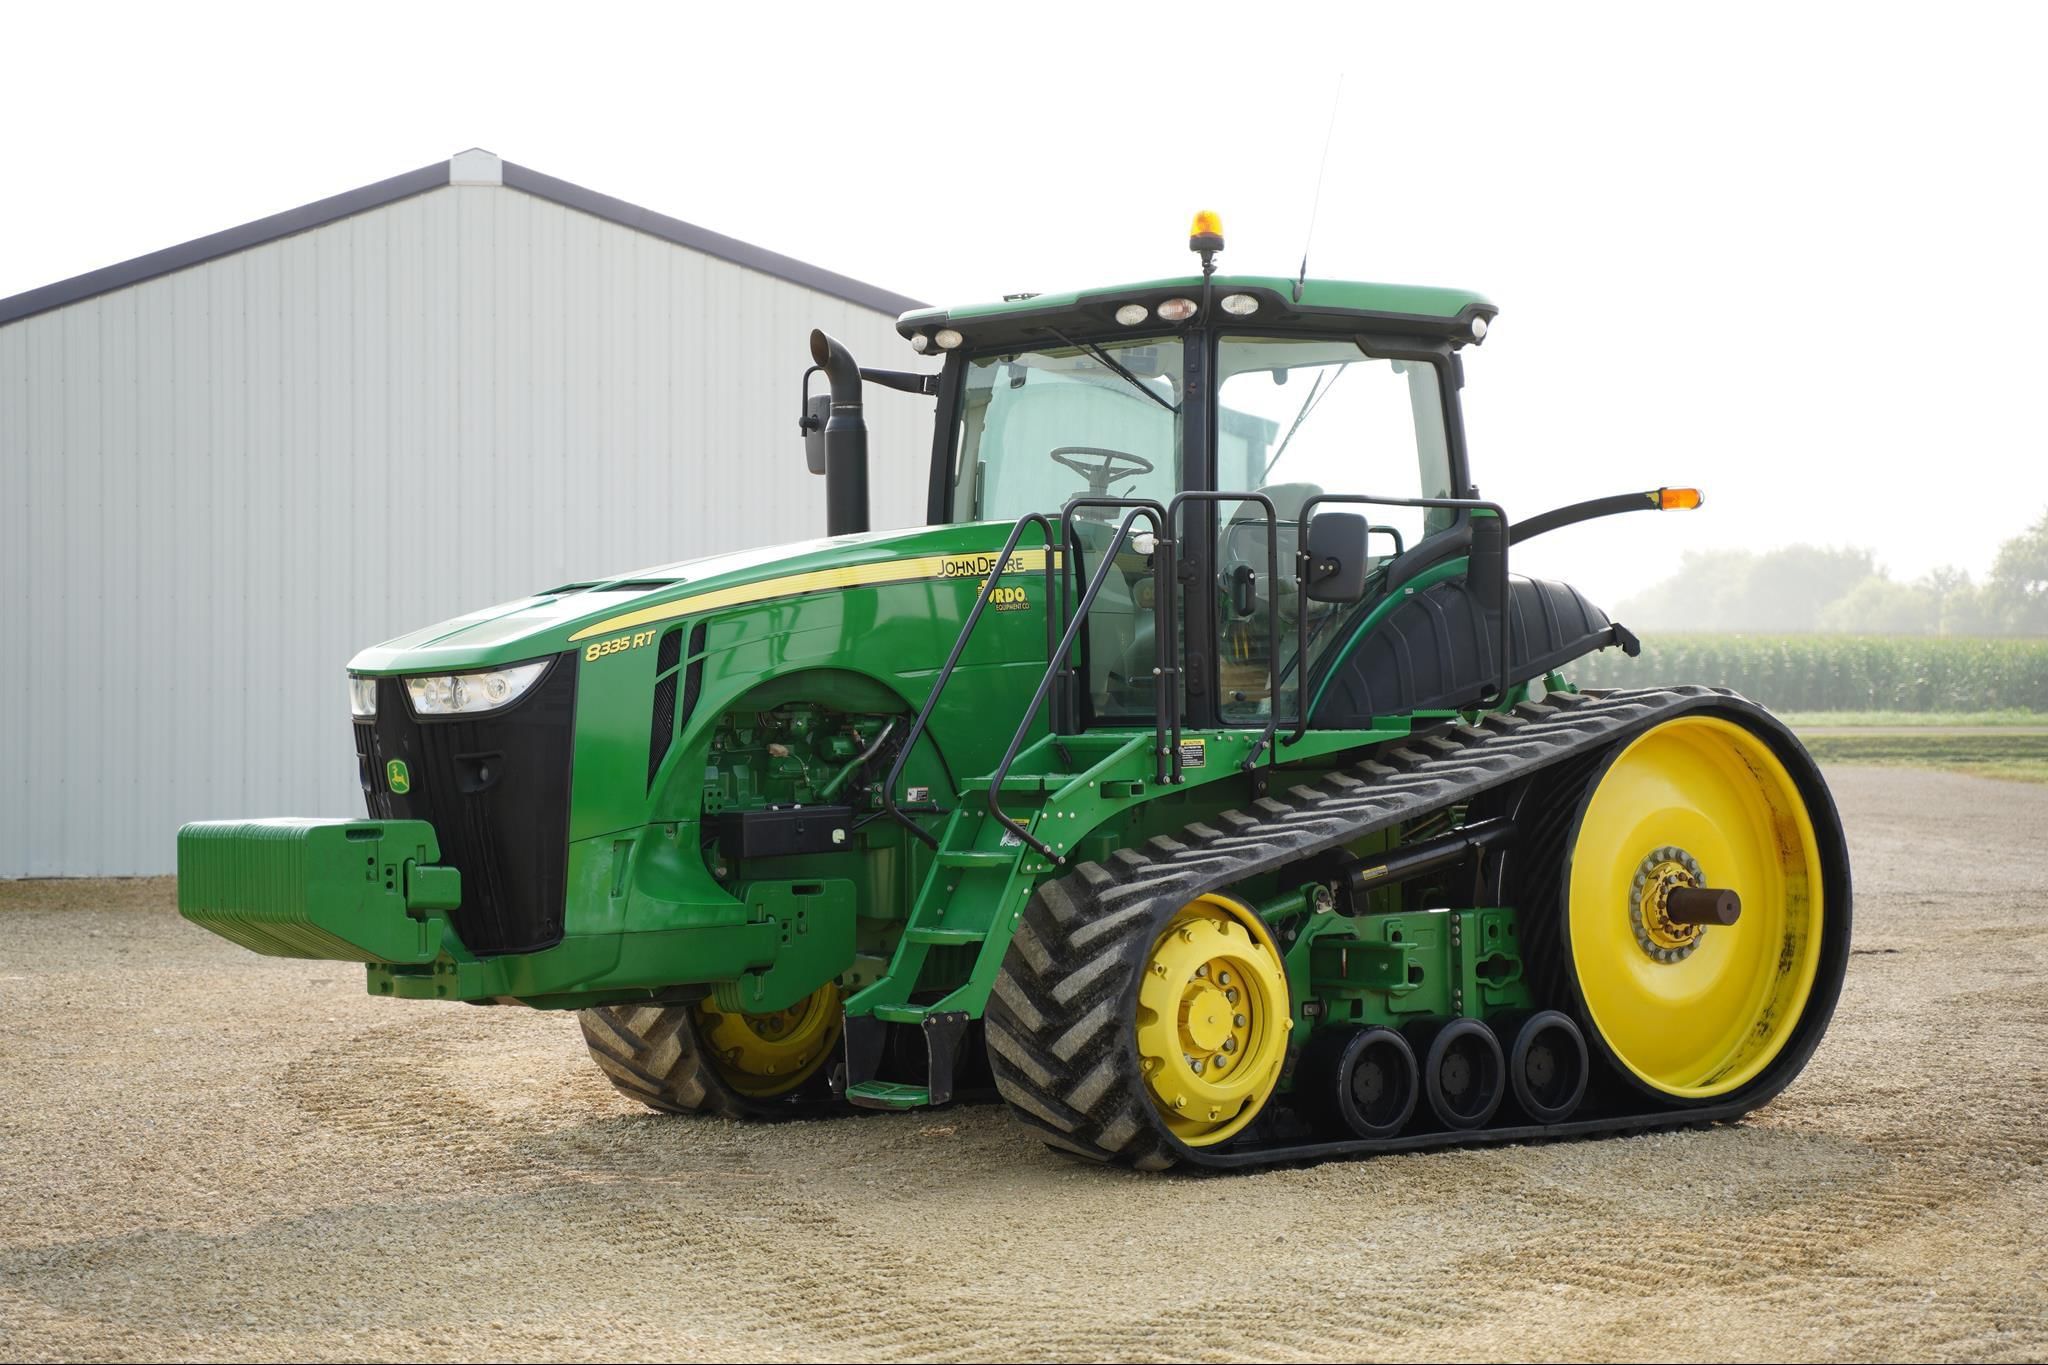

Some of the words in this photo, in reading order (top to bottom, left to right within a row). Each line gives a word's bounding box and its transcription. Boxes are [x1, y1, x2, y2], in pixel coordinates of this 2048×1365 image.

[938, 560, 976, 576] JOHN
[977, 557, 1024, 573] DERE
[995, 587, 1025, 603] RDO
[585, 636, 631, 662] 8335
[632, 630, 656, 649] RT
